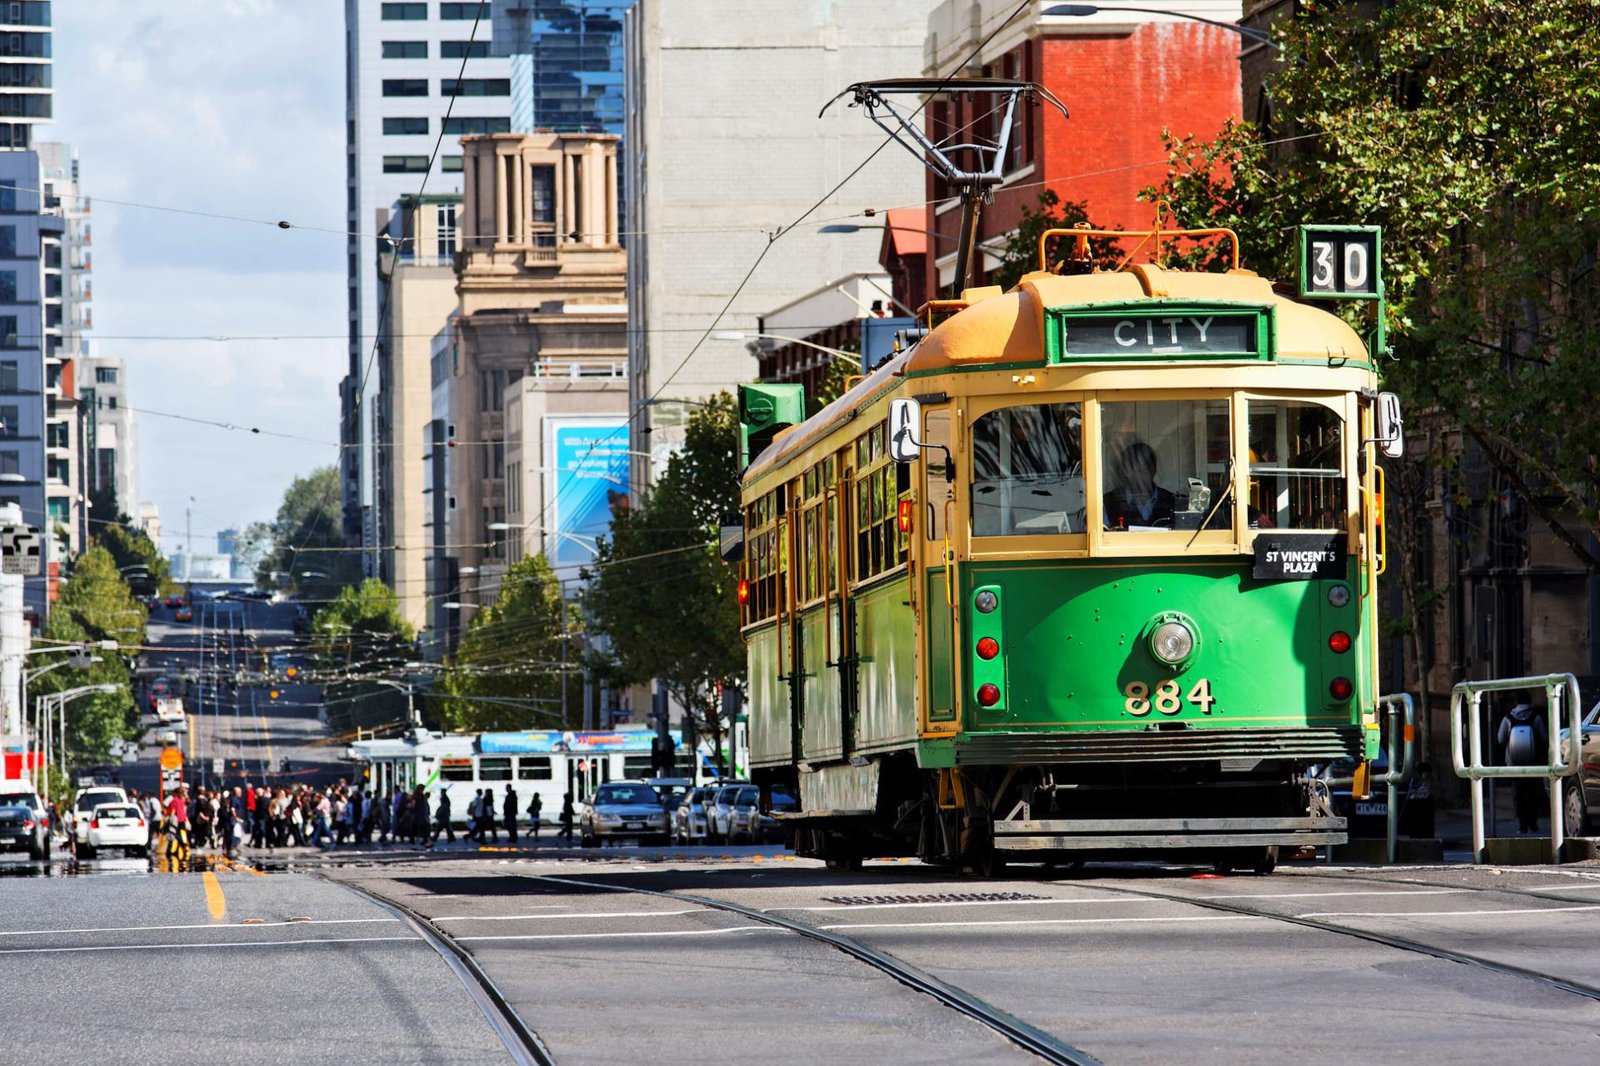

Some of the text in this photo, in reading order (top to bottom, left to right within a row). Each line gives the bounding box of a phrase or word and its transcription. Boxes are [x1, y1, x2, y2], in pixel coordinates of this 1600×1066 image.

[1312, 241, 1367, 287] 30
[1113, 316, 1214, 347] CITY
[1265, 551, 1336, 562] ST VINCENT'S
[1283, 562, 1318, 573] PLAZA
[1124, 678, 1214, 716] 884
